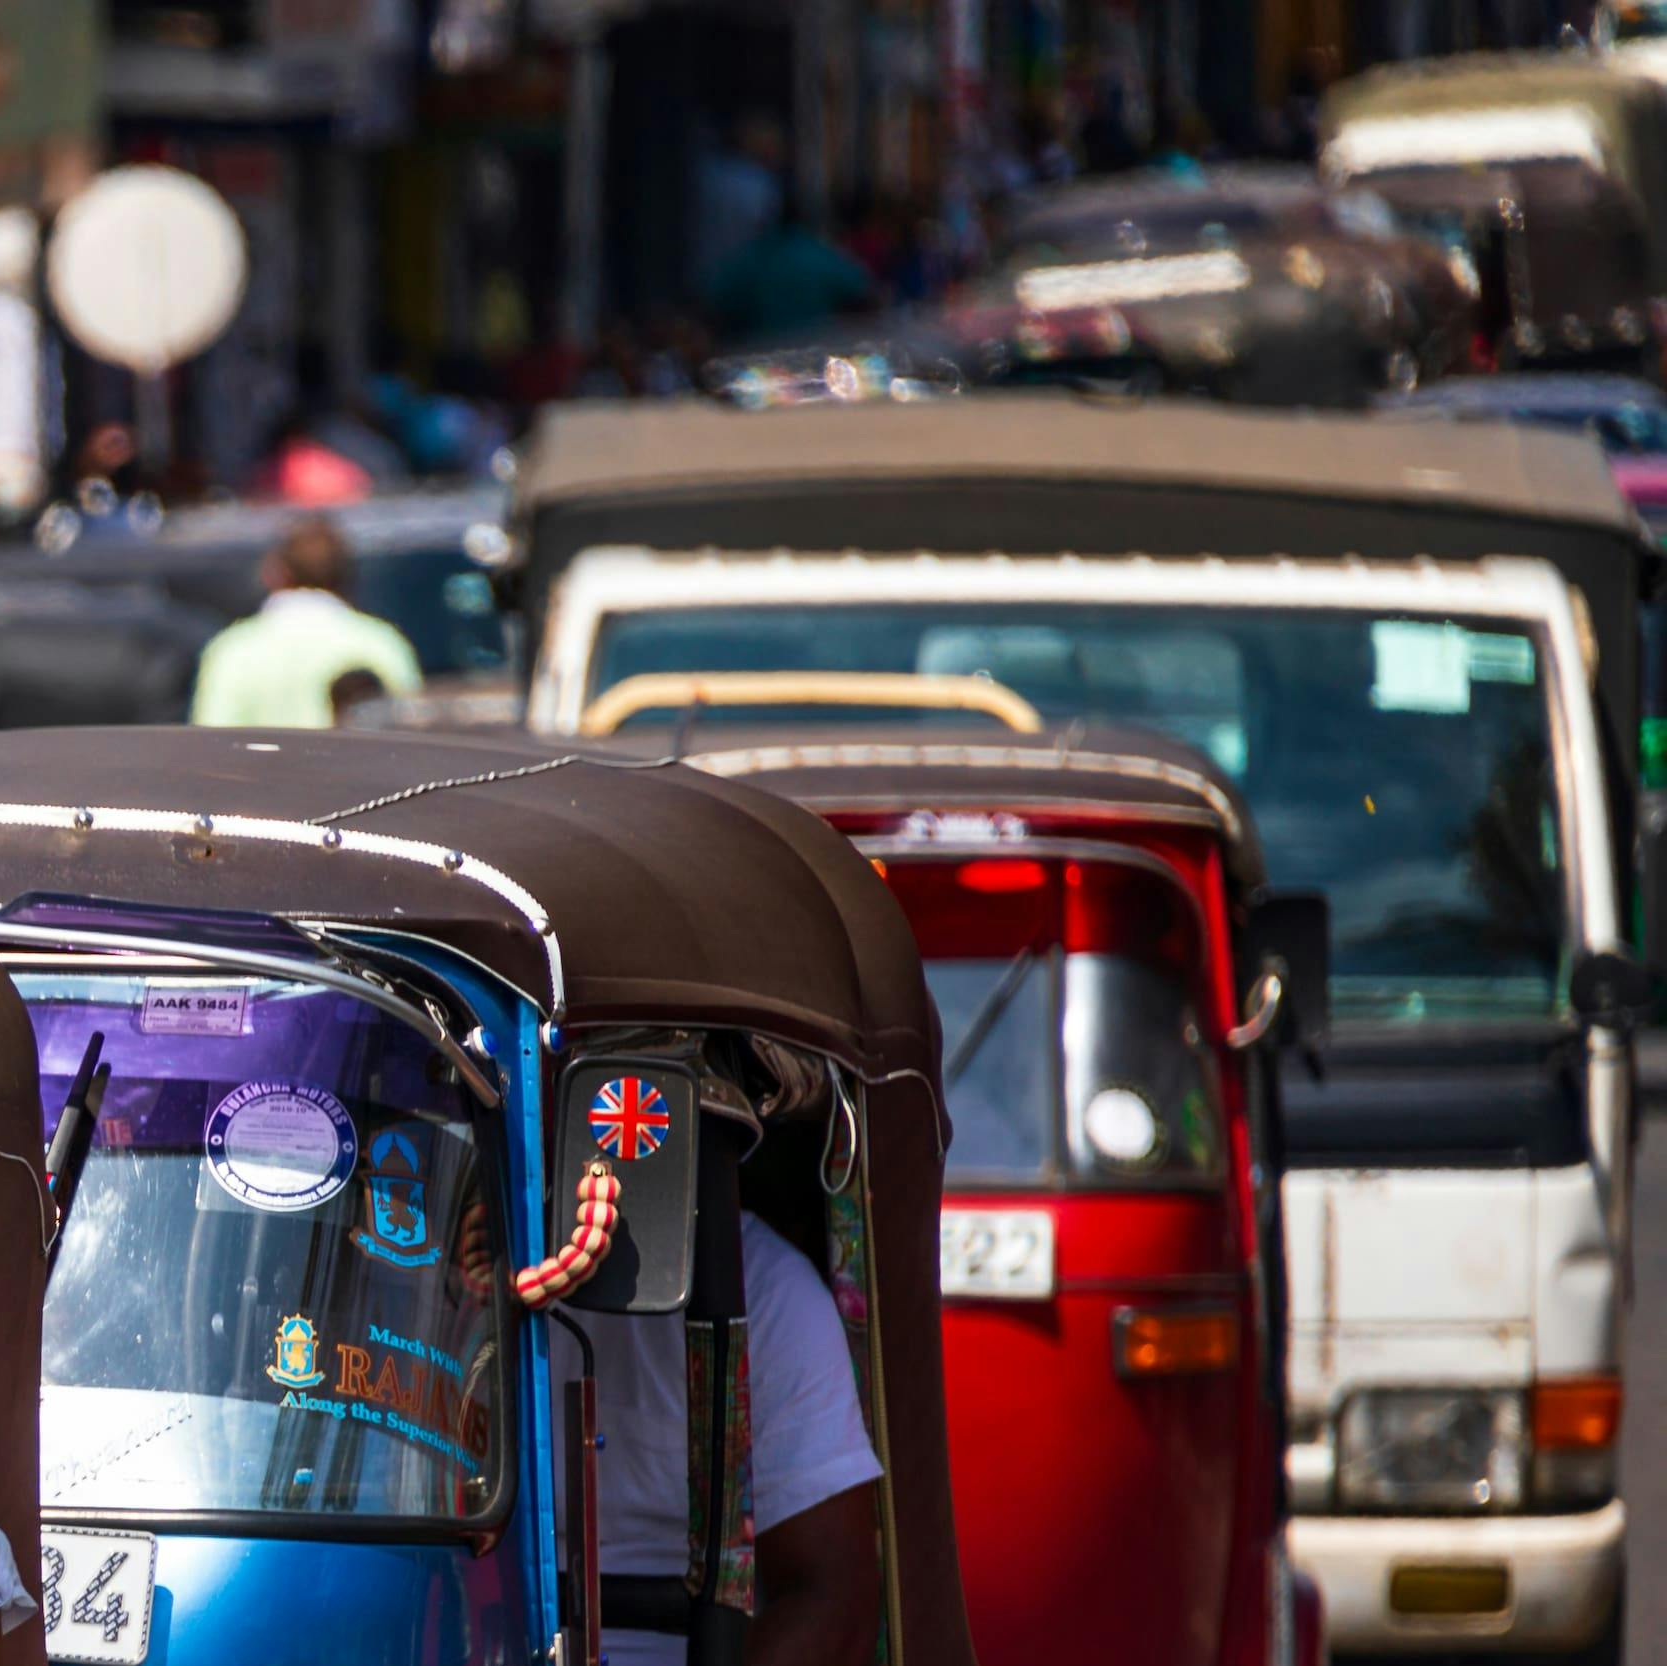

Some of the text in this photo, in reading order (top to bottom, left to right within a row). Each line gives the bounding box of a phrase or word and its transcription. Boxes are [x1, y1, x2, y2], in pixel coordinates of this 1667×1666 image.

[153, 998, 238, 1011] AAK 9484
[368, 1324, 463, 1378] March With
[279, 1391, 347, 1420] Along
[351, 1402, 382, 1424] the
[387, 1411, 452, 1454] Superior
